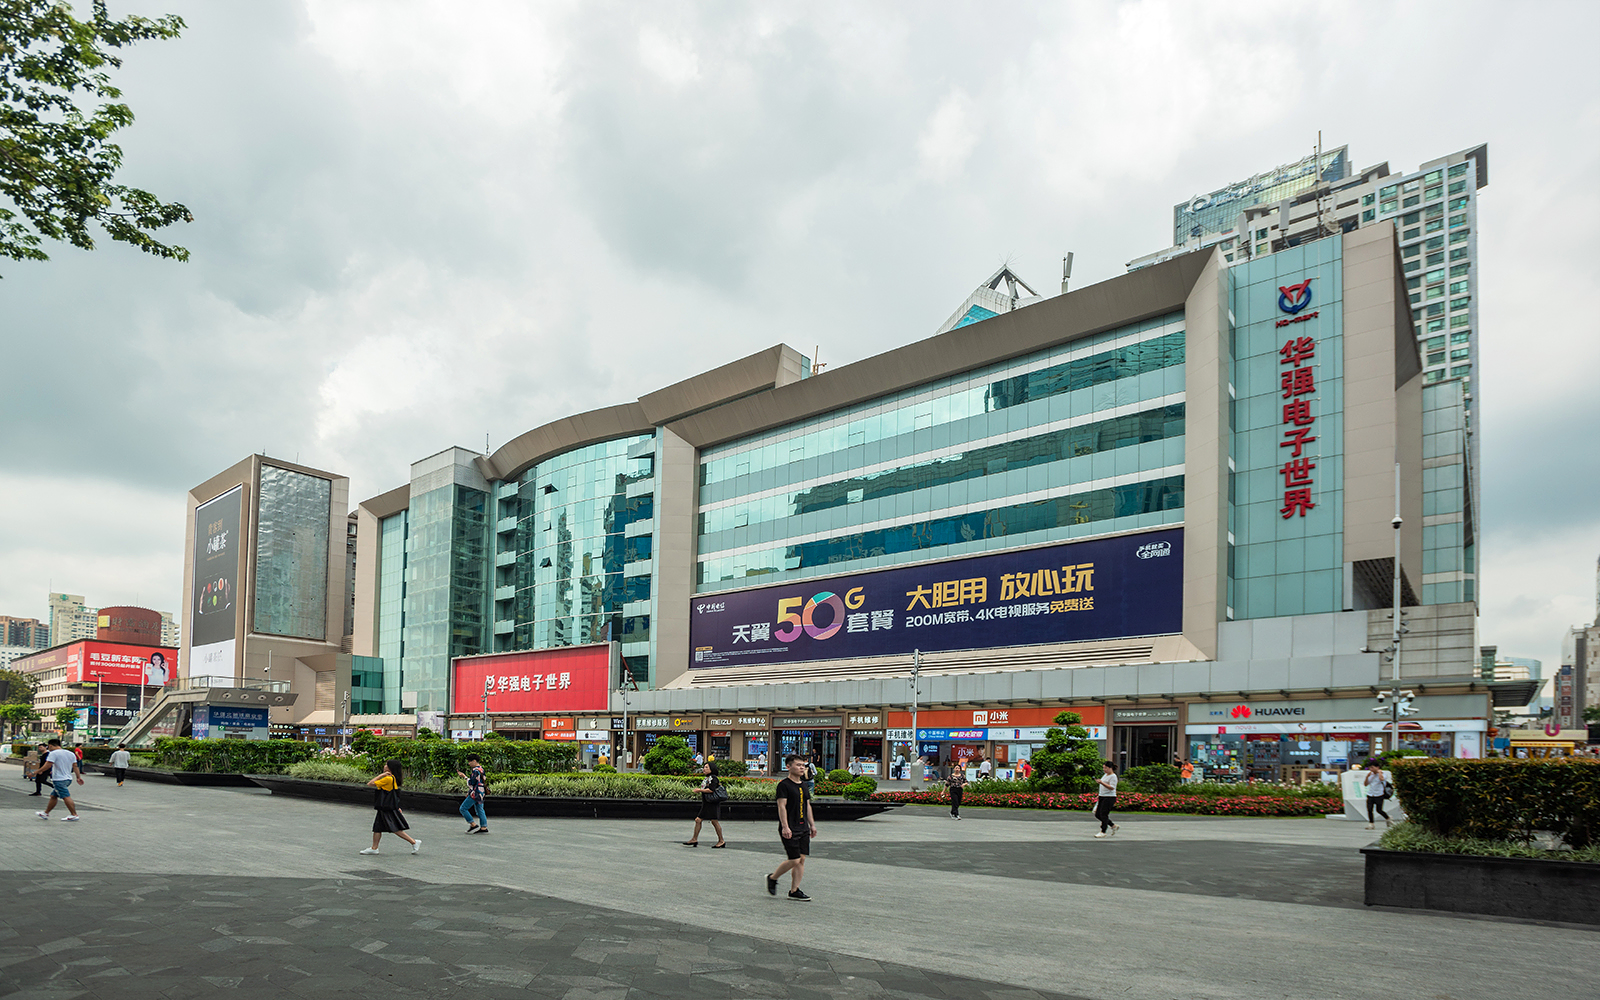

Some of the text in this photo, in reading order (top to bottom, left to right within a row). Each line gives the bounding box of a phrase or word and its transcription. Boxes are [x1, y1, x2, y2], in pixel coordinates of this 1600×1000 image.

[1279, 335, 1316, 519] 华强电子世界
[906, 562, 1094, 611] 大胆用 放心玩
[905, 596, 1095, 627] 200M宽带、4K电视服务免费送
[732, 622, 770, 644] 天翼
[847, 609, 894, 633] 套餐
[90, 652, 141, 664] 毛豆新车网
[497, 672, 571, 693] 华强电子世界
[990, 711, 1008, 720] 小米
[1255, 707, 1305, 716] HUAWEI
[849, 716, 879, 724] 手机维修
[887, 730, 913, 739] 手机维修
[957, 748, 974, 757] 小米
